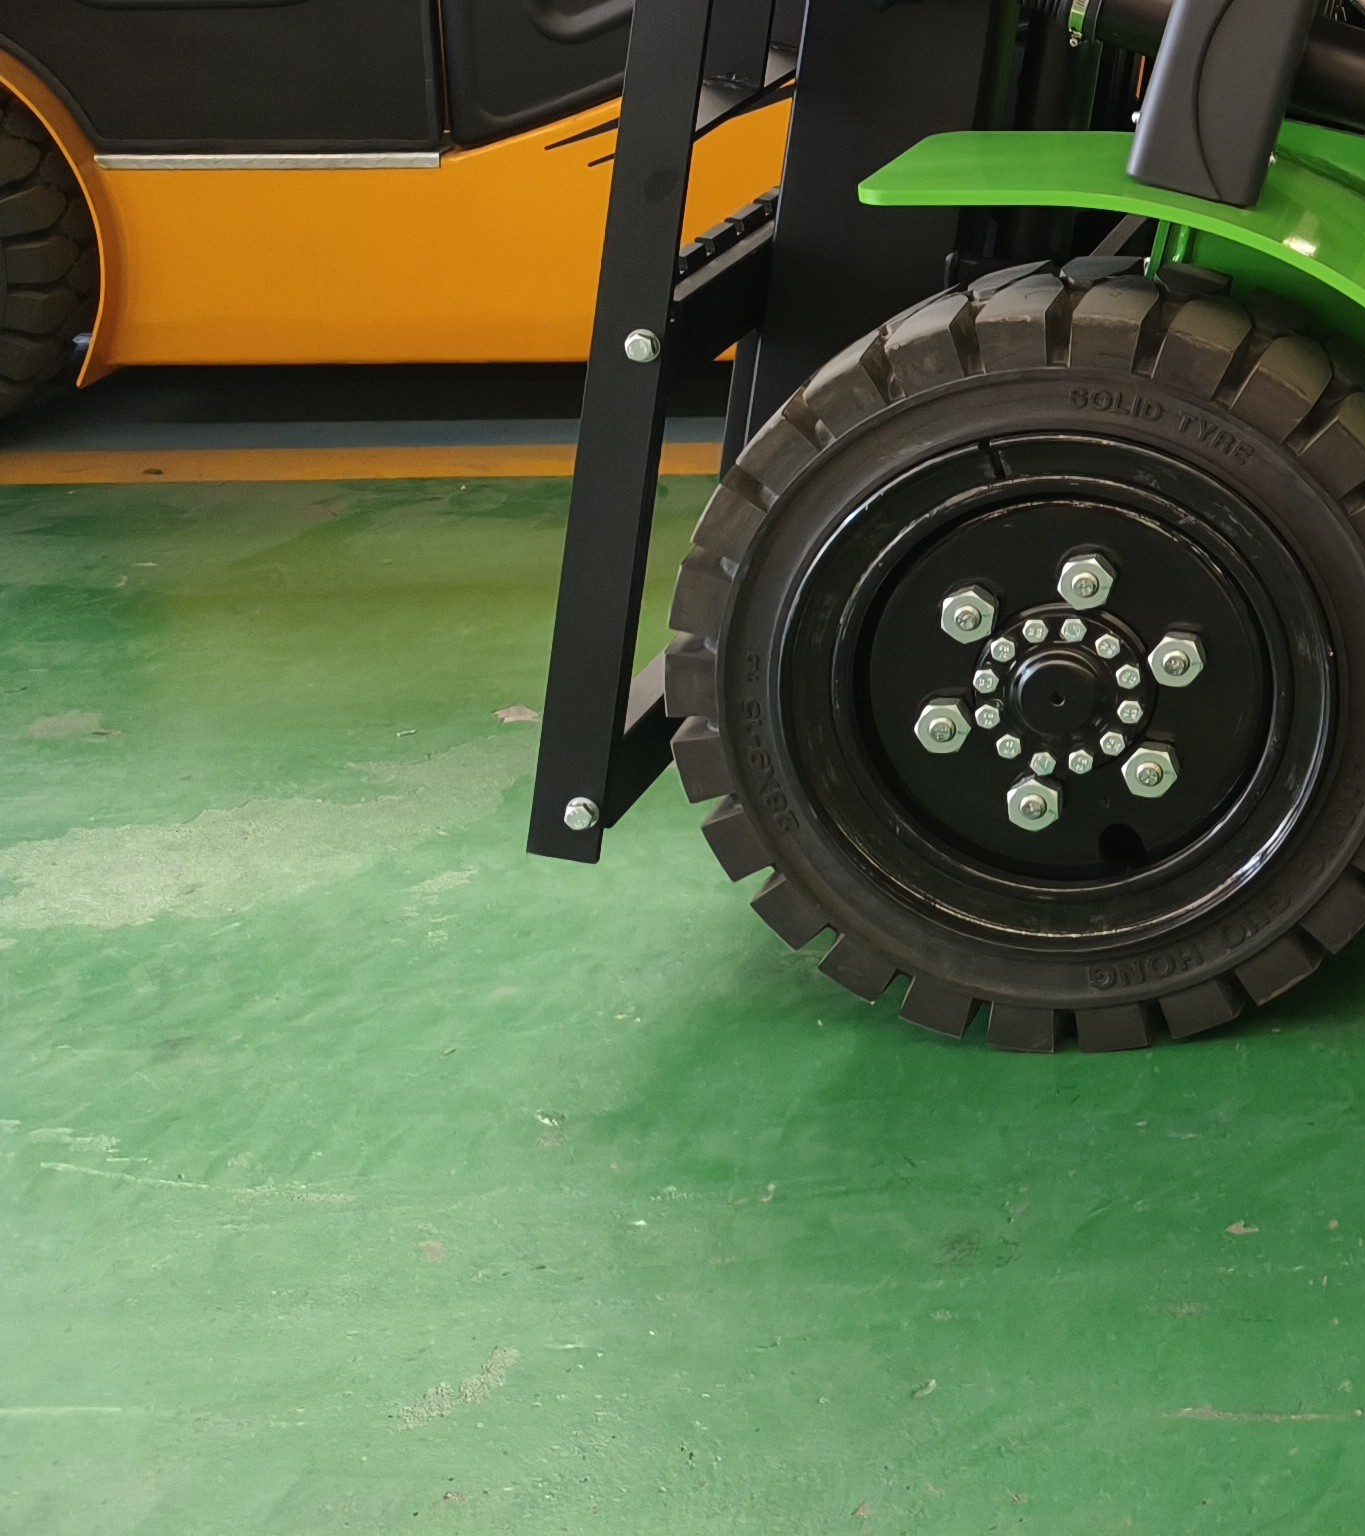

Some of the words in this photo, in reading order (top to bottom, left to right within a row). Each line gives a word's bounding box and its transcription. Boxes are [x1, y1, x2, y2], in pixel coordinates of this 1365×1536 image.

[1068, 387, 1165, 422] SOLID
[1177, 409, 1257, 466] TYRE
[1086, 941, 1205, 991] HONG
